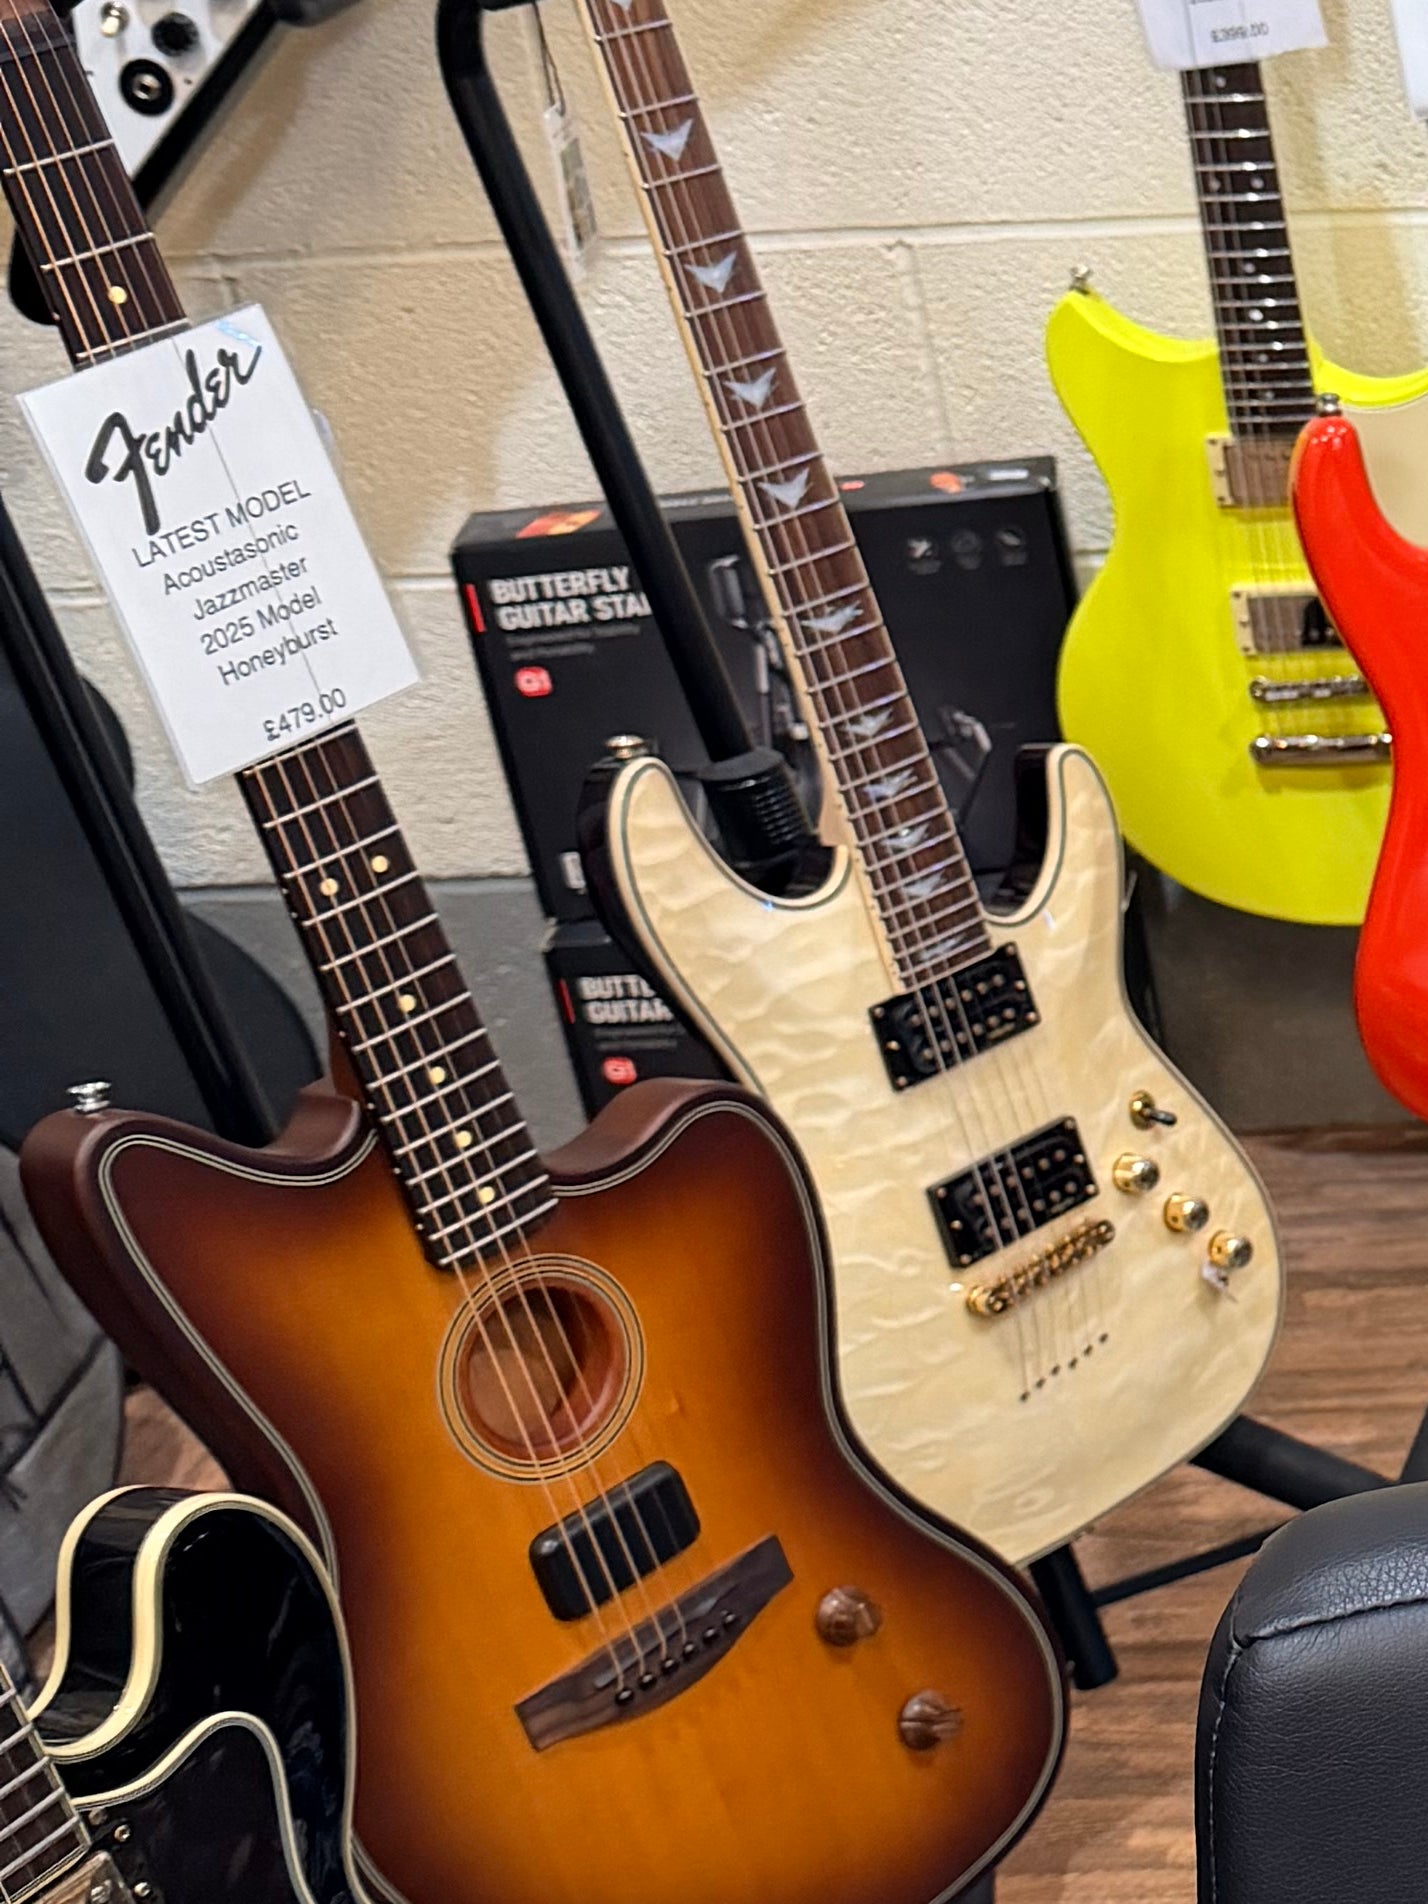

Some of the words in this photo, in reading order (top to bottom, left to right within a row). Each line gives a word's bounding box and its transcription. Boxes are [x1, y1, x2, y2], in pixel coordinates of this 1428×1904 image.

[86, 345, 262, 537] Fender
[132, 511, 220, 569] LATEST
[227, 479, 312, 525] MODEL
[162, 520, 300, 596] Acoustasonic
[193, 552, 309, 622] Jazzmaster
[488, 565, 629, 604] BUTTERFLY
[497, 597, 589, 631] GUITAR
[200, 621, 256, 656] 2025
[259, 587, 323, 631] Model
[218, 618, 339, 687] Honeyburst
[263, 687, 347, 742] £479.00
